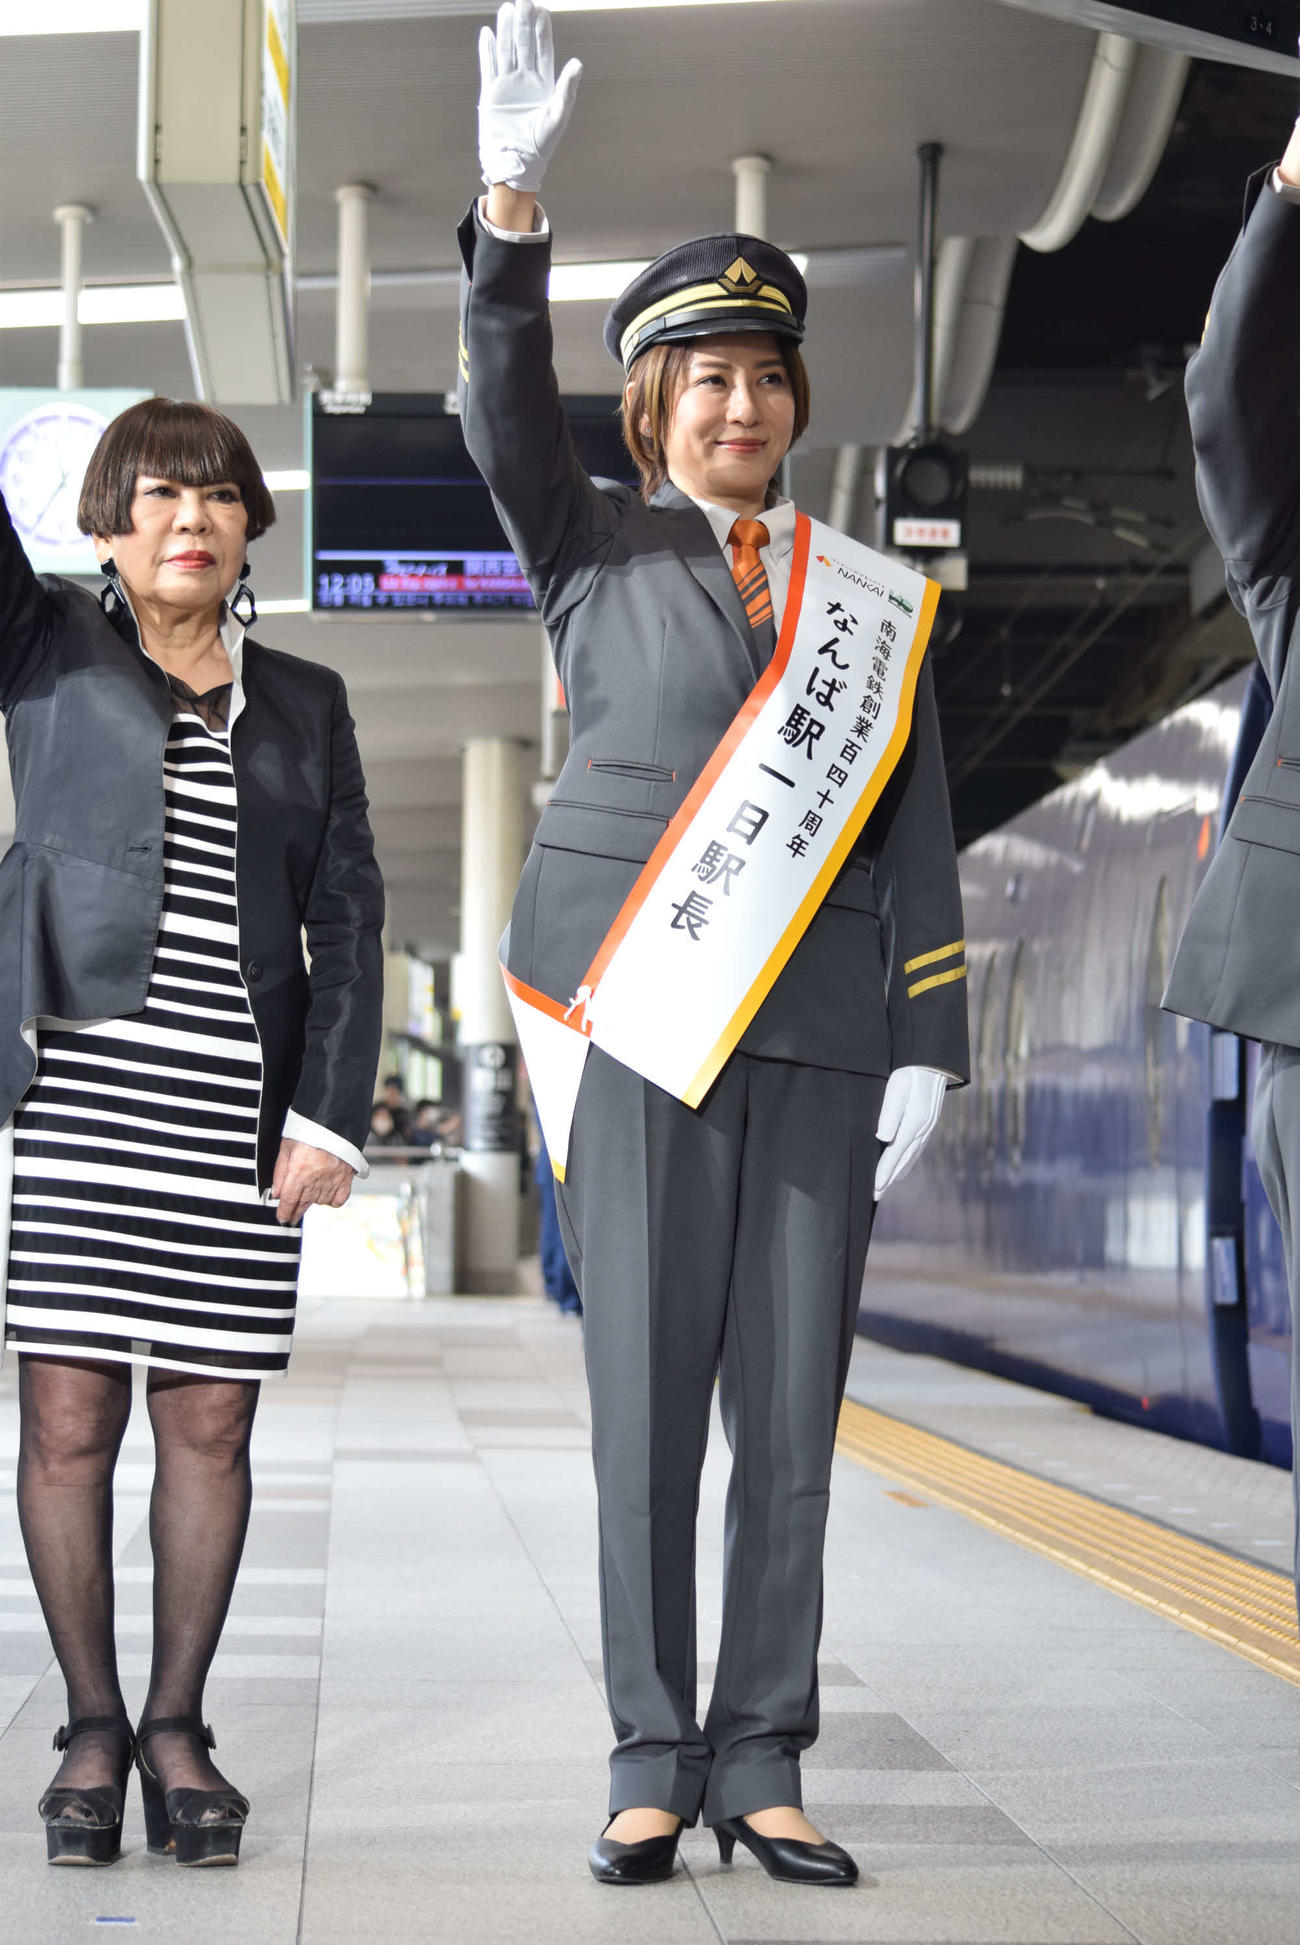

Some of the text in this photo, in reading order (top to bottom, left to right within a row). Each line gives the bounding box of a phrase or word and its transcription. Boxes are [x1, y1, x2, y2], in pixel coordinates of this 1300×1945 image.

[837, 567, 884, 597] NANKAI
[670, 601, 859, 942] なんば駅一日駅長
[786, 618, 897, 859] 南海電鉄創業百四十周年
